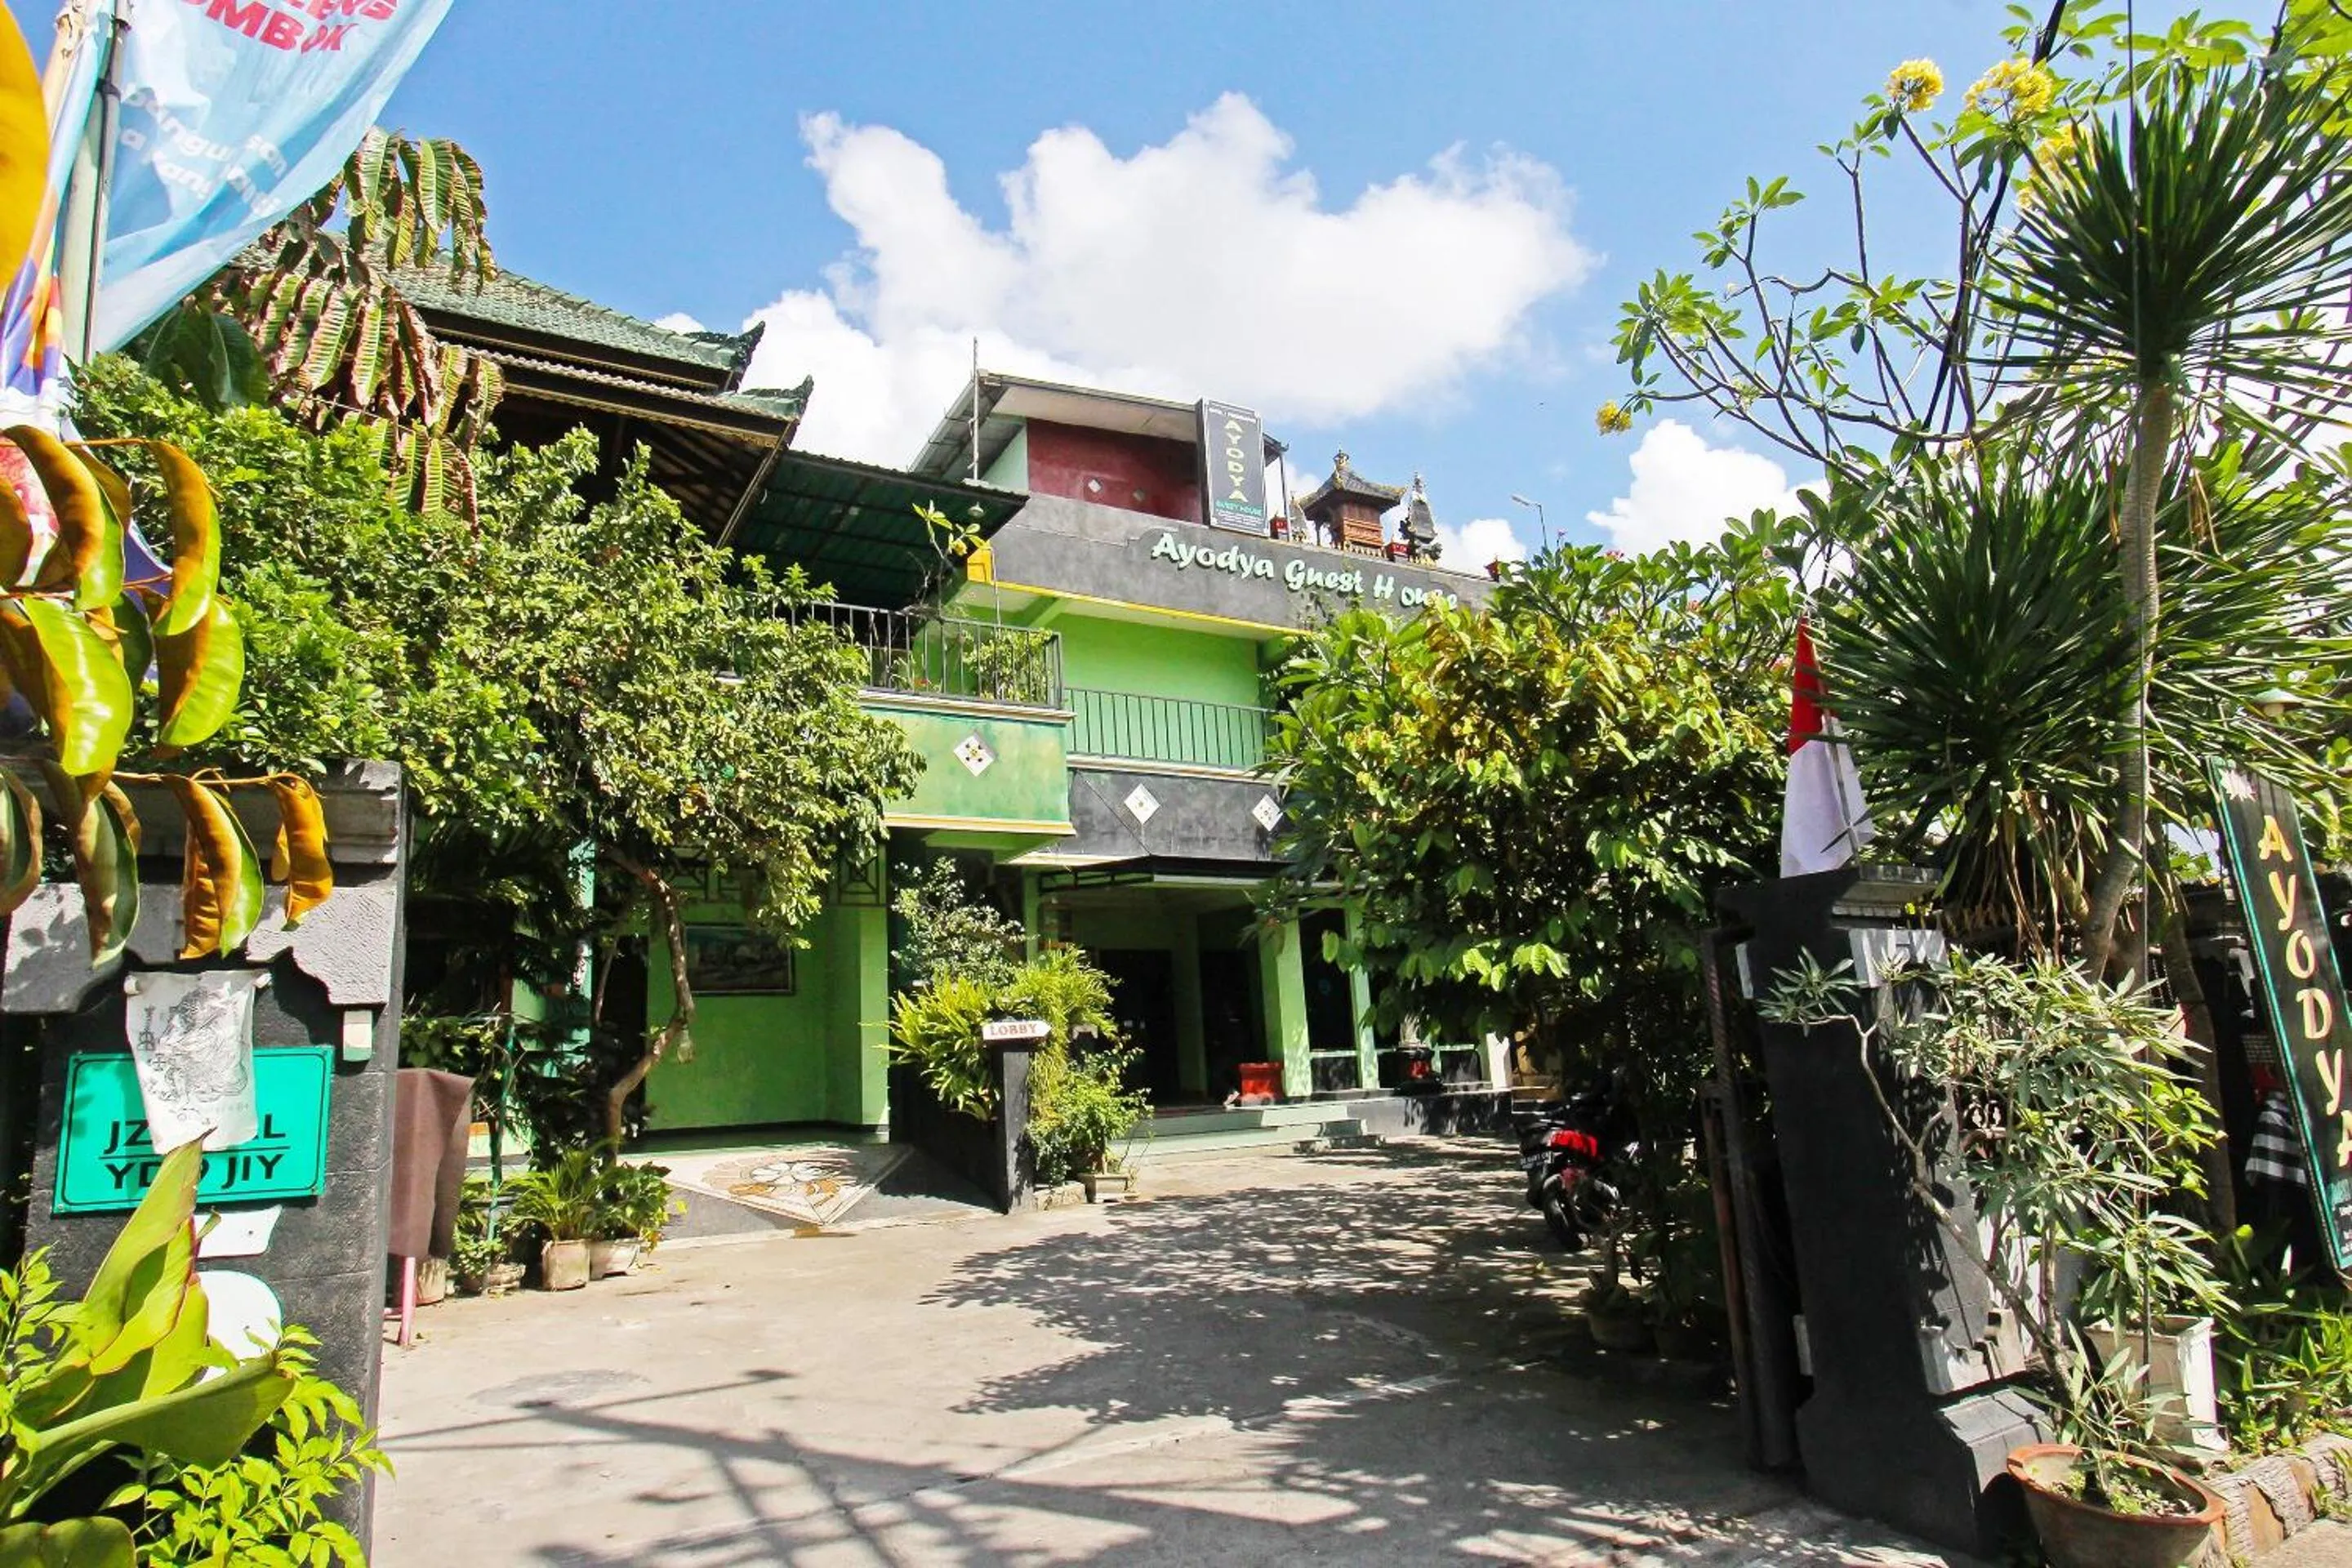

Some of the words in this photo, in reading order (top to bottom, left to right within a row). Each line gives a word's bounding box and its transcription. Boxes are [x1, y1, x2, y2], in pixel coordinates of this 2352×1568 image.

[1224, 419, 1249, 503] AYODYA
[1151, 532, 1275, 577] Ayodya
[1284, 559, 1365, 595] Guest
[990, 1023, 1037, 1036] LOBBY
[220, 1153, 285, 1190] JIY
